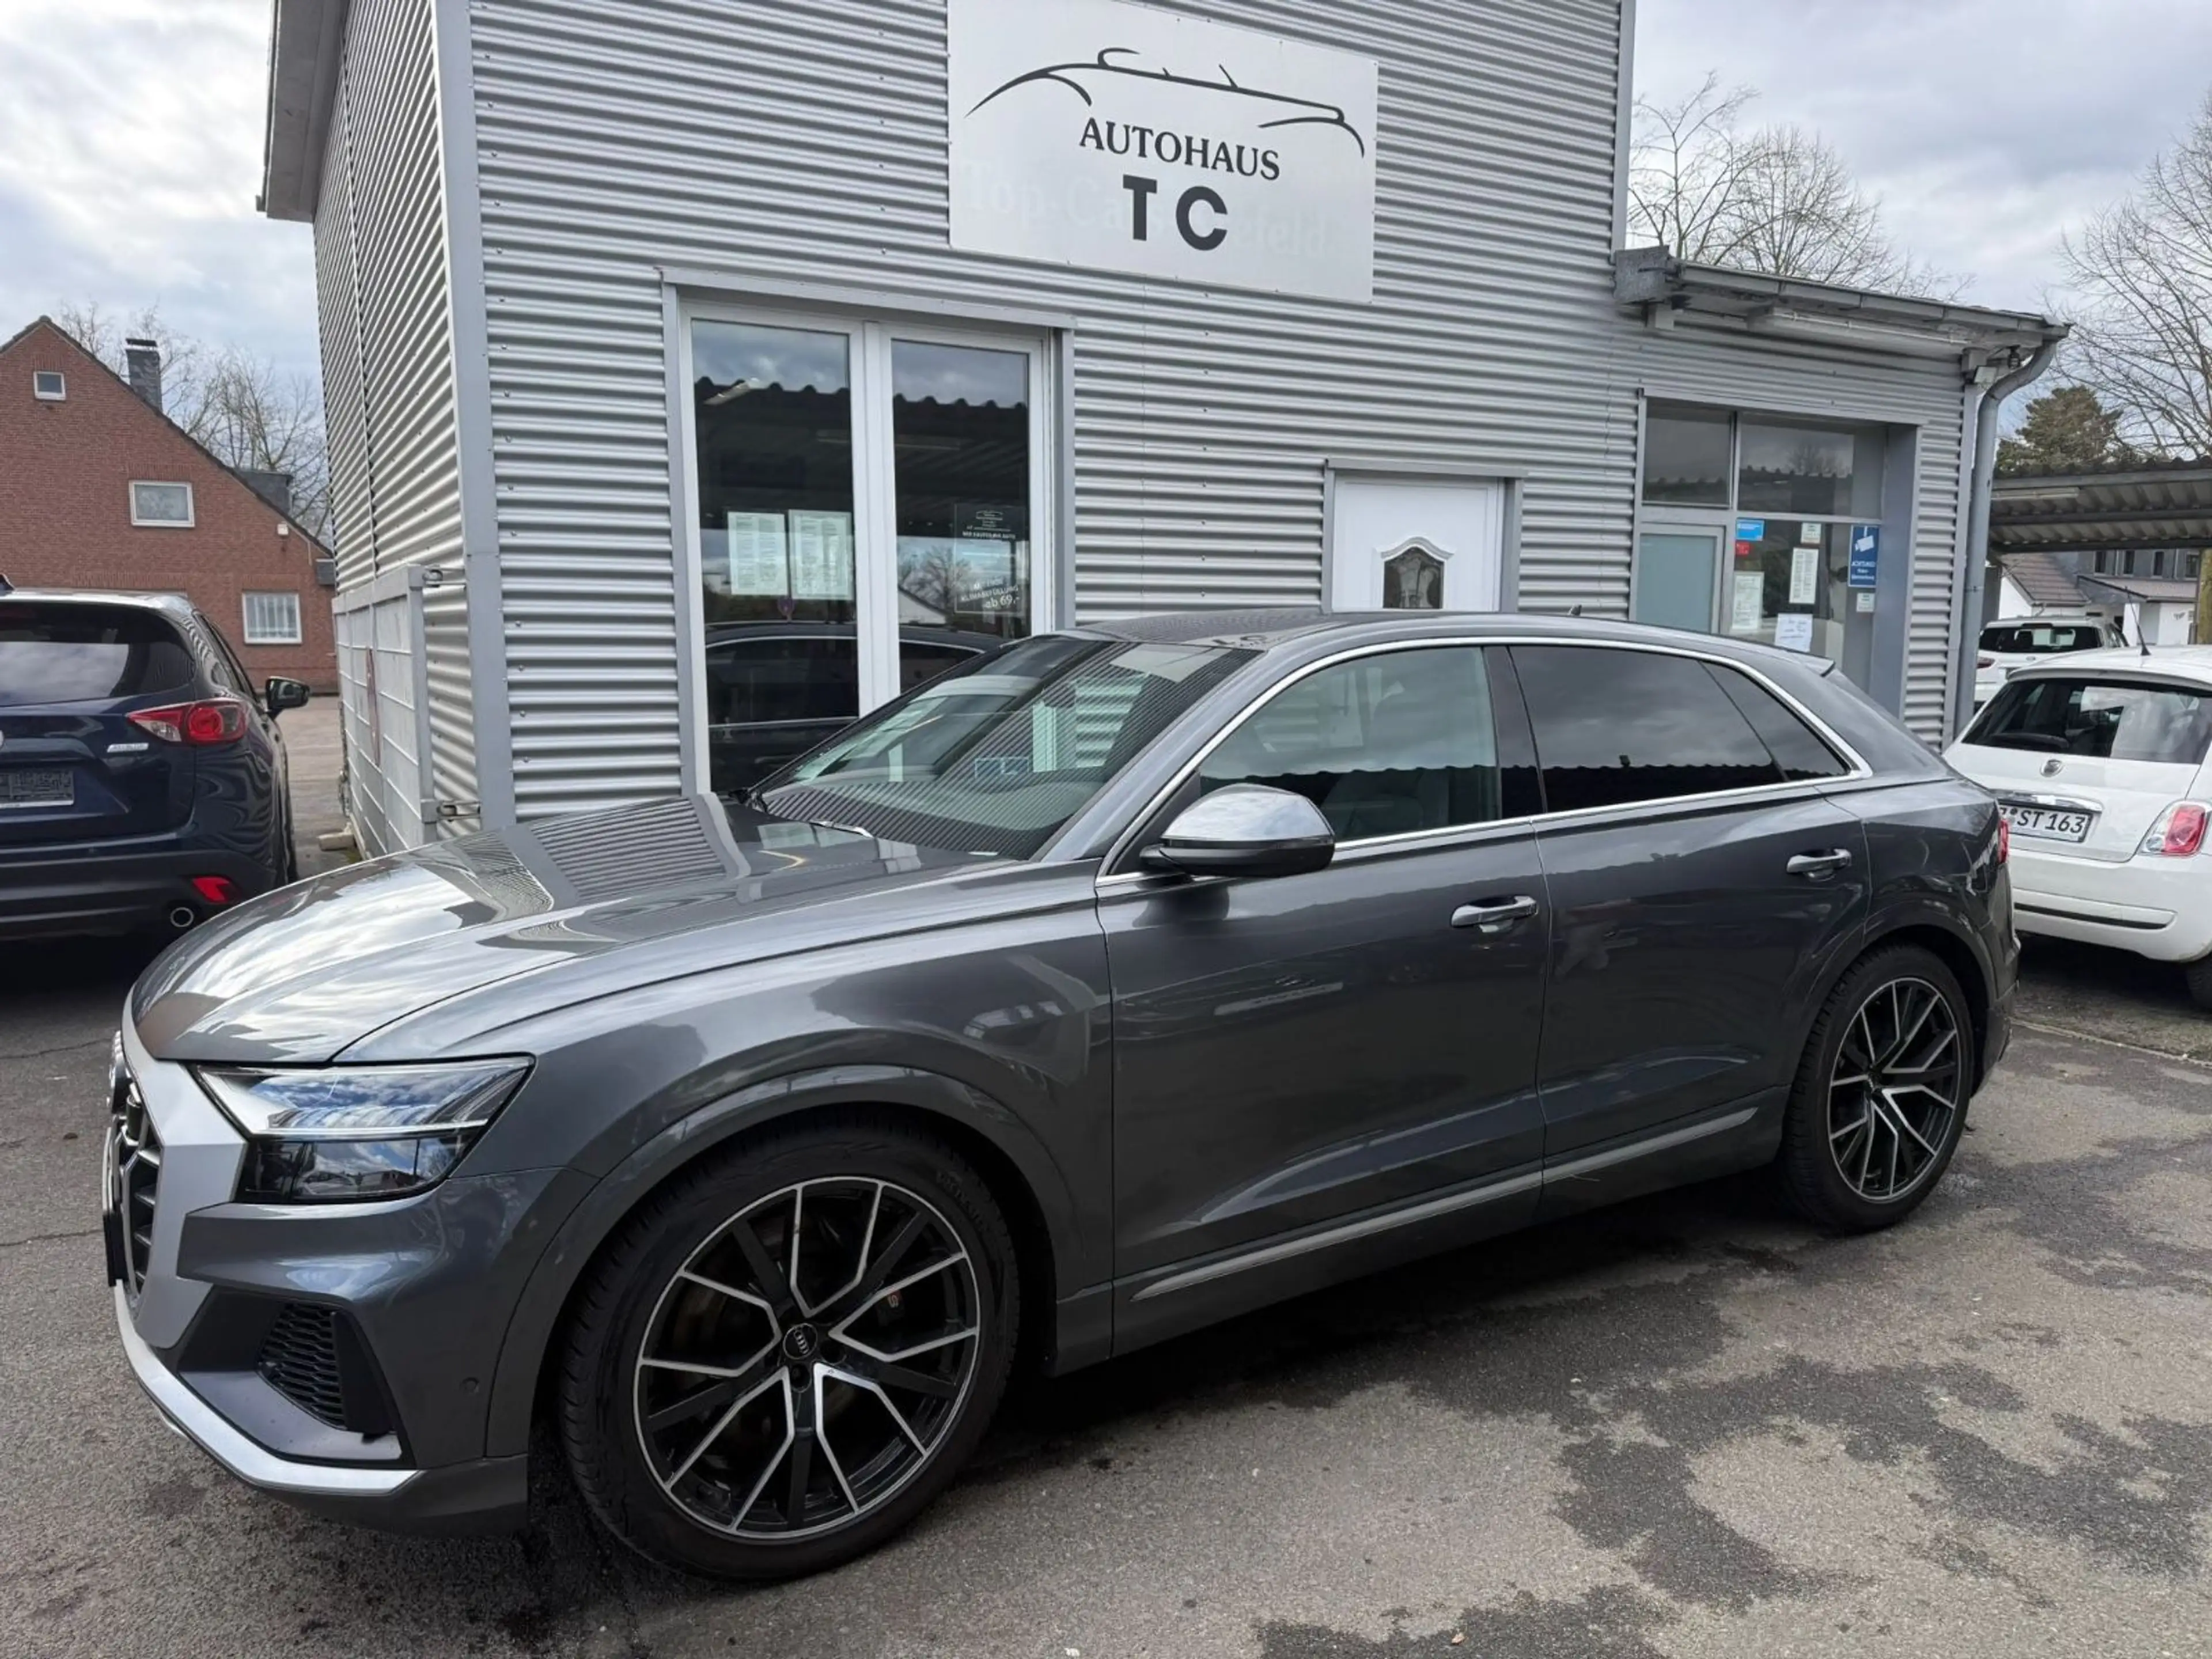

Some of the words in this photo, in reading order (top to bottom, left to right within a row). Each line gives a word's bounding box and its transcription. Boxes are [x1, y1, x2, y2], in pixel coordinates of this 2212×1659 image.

[1080, 117, 1280, 180] AUTOHAUS
[1123, 174, 1158, 241] T
[1176, 185, 1228, 251] C
[2017, 810, 2044, 828] ST
[2045, 813, 2085, 834] 163
